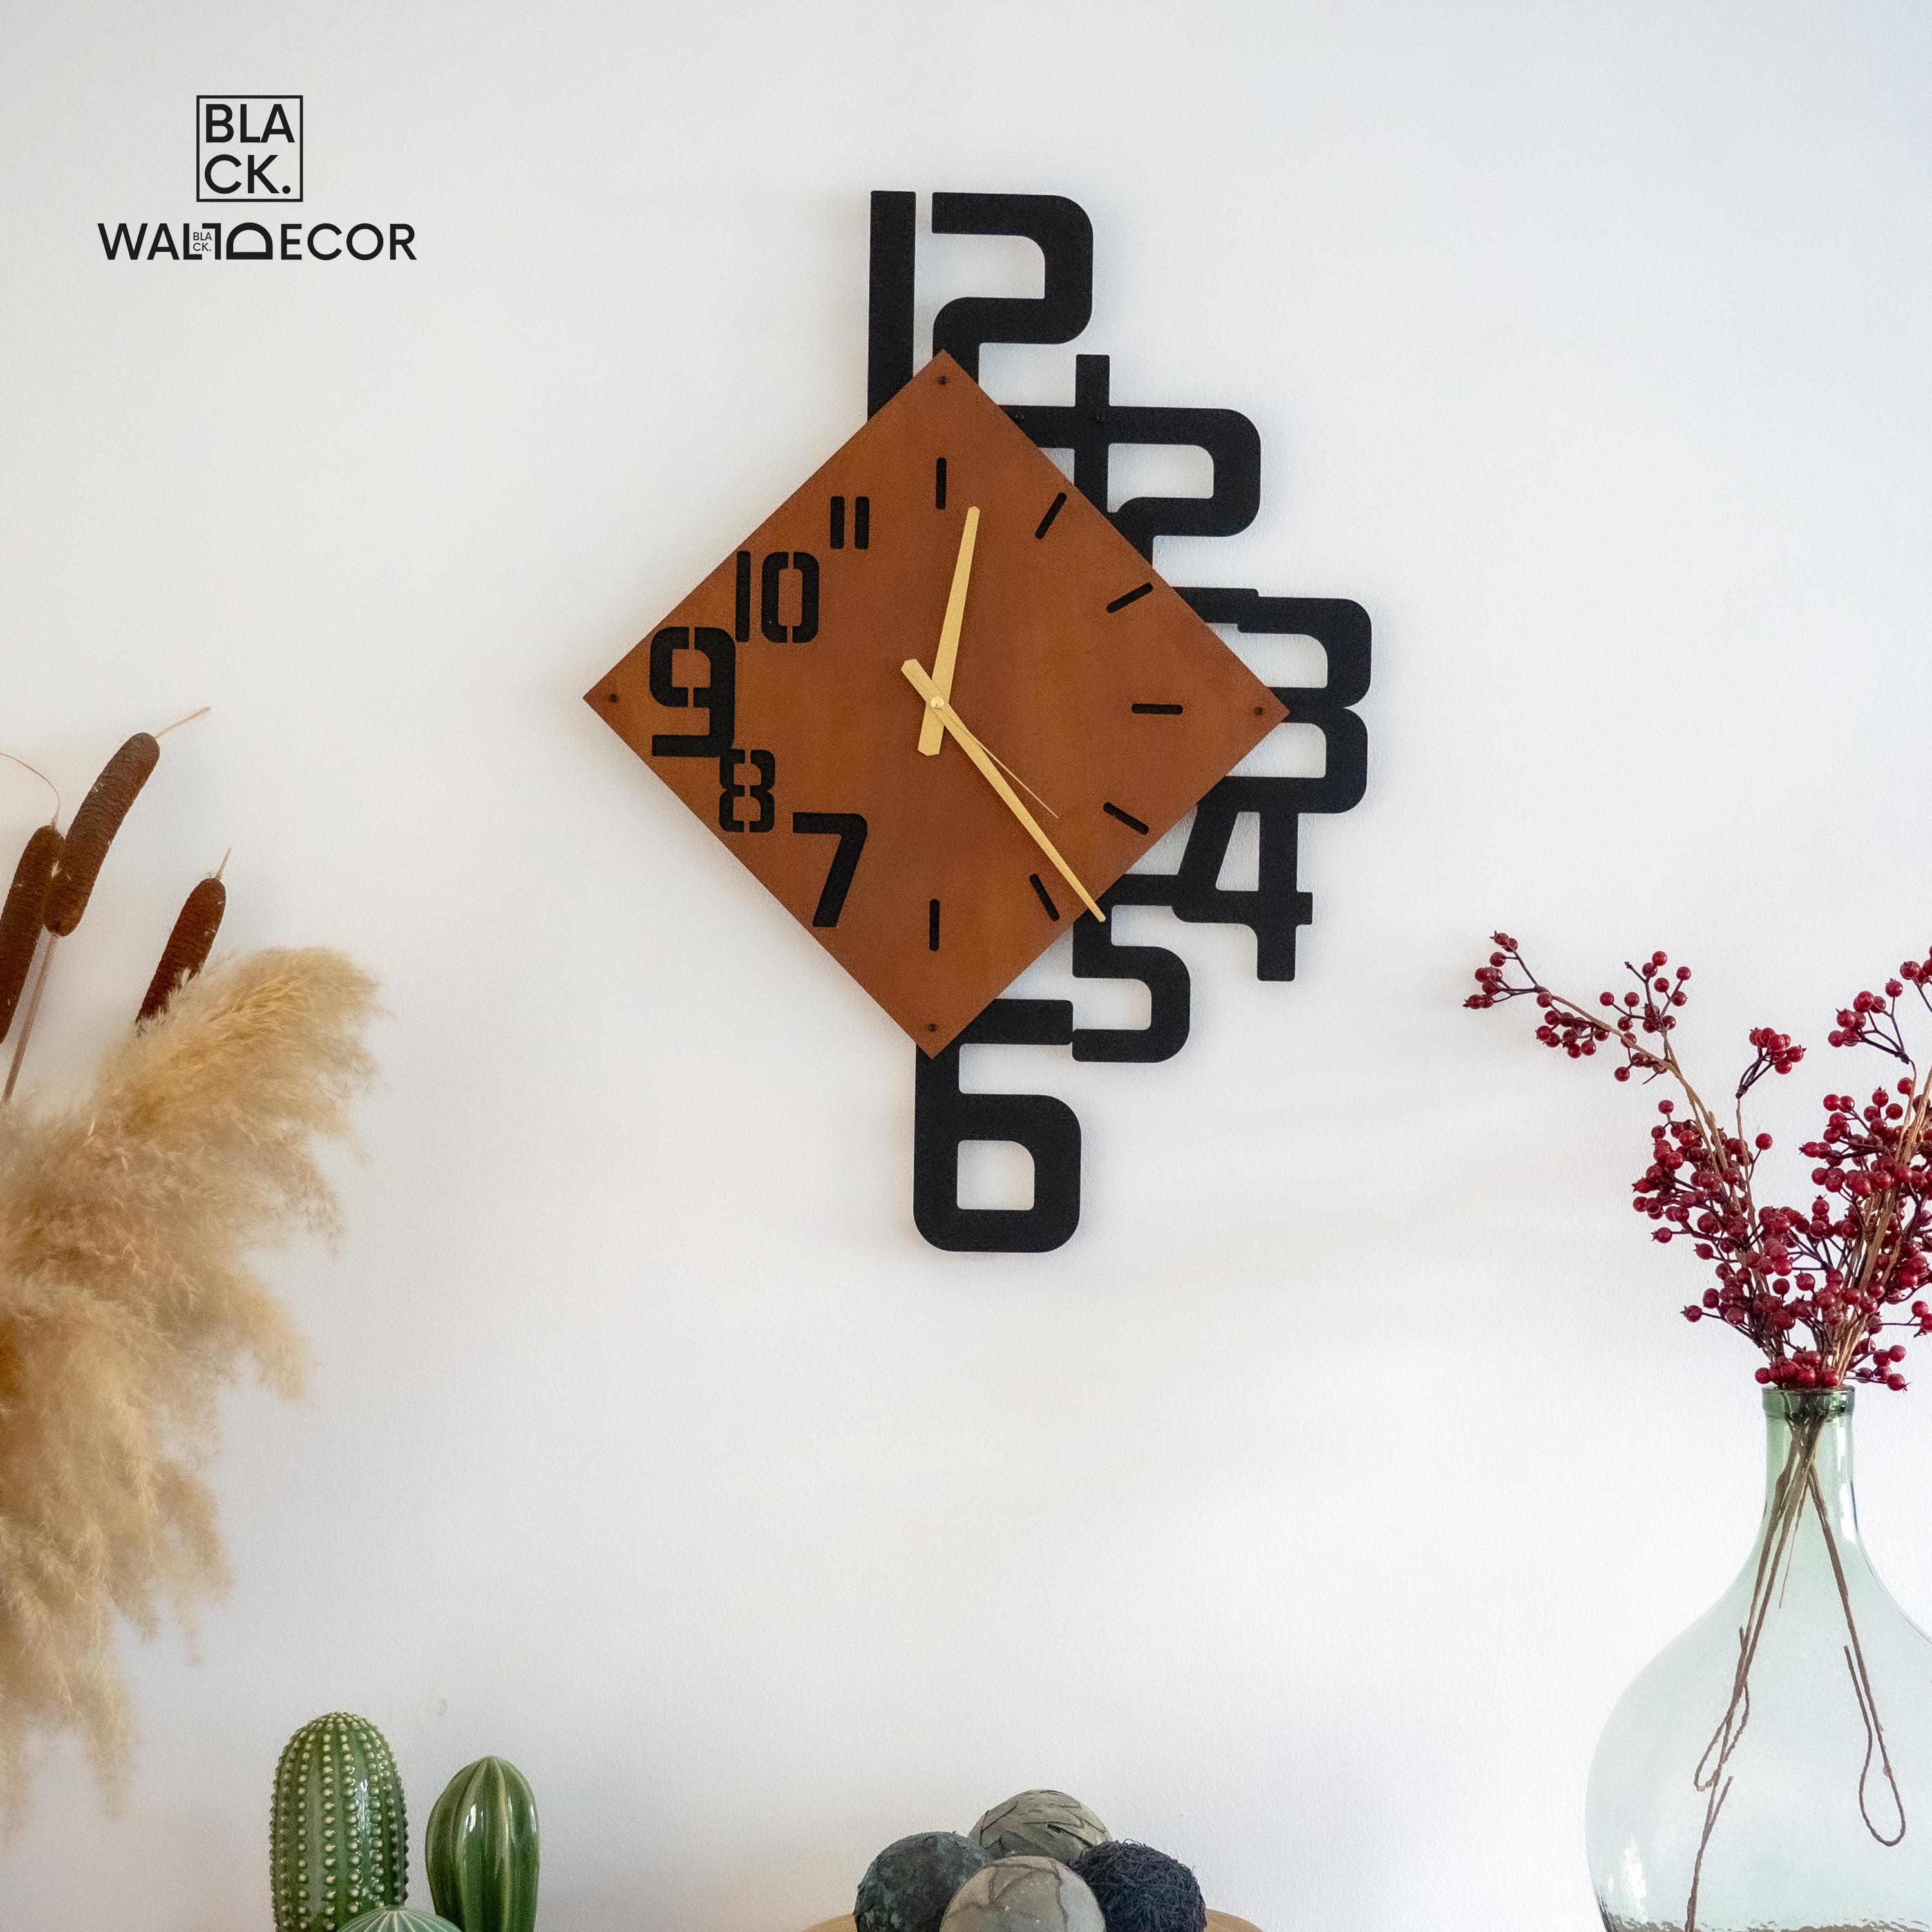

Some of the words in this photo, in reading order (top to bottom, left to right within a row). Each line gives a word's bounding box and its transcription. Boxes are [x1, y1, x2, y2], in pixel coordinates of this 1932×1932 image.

[867, 191, 1094, 424] 12
[735, 551, 820, 643] 10
[649, 626, 736, 757] 9
[1237, 597, 1372, 813] 3
[719, 749, 775, 833] 8
[792, 811, 867, 927] 7
[1172, 778, 1313, 981] 4
[1072, 875, 1191, 1063] 5
[913, 998, 1082, 1253] 6
